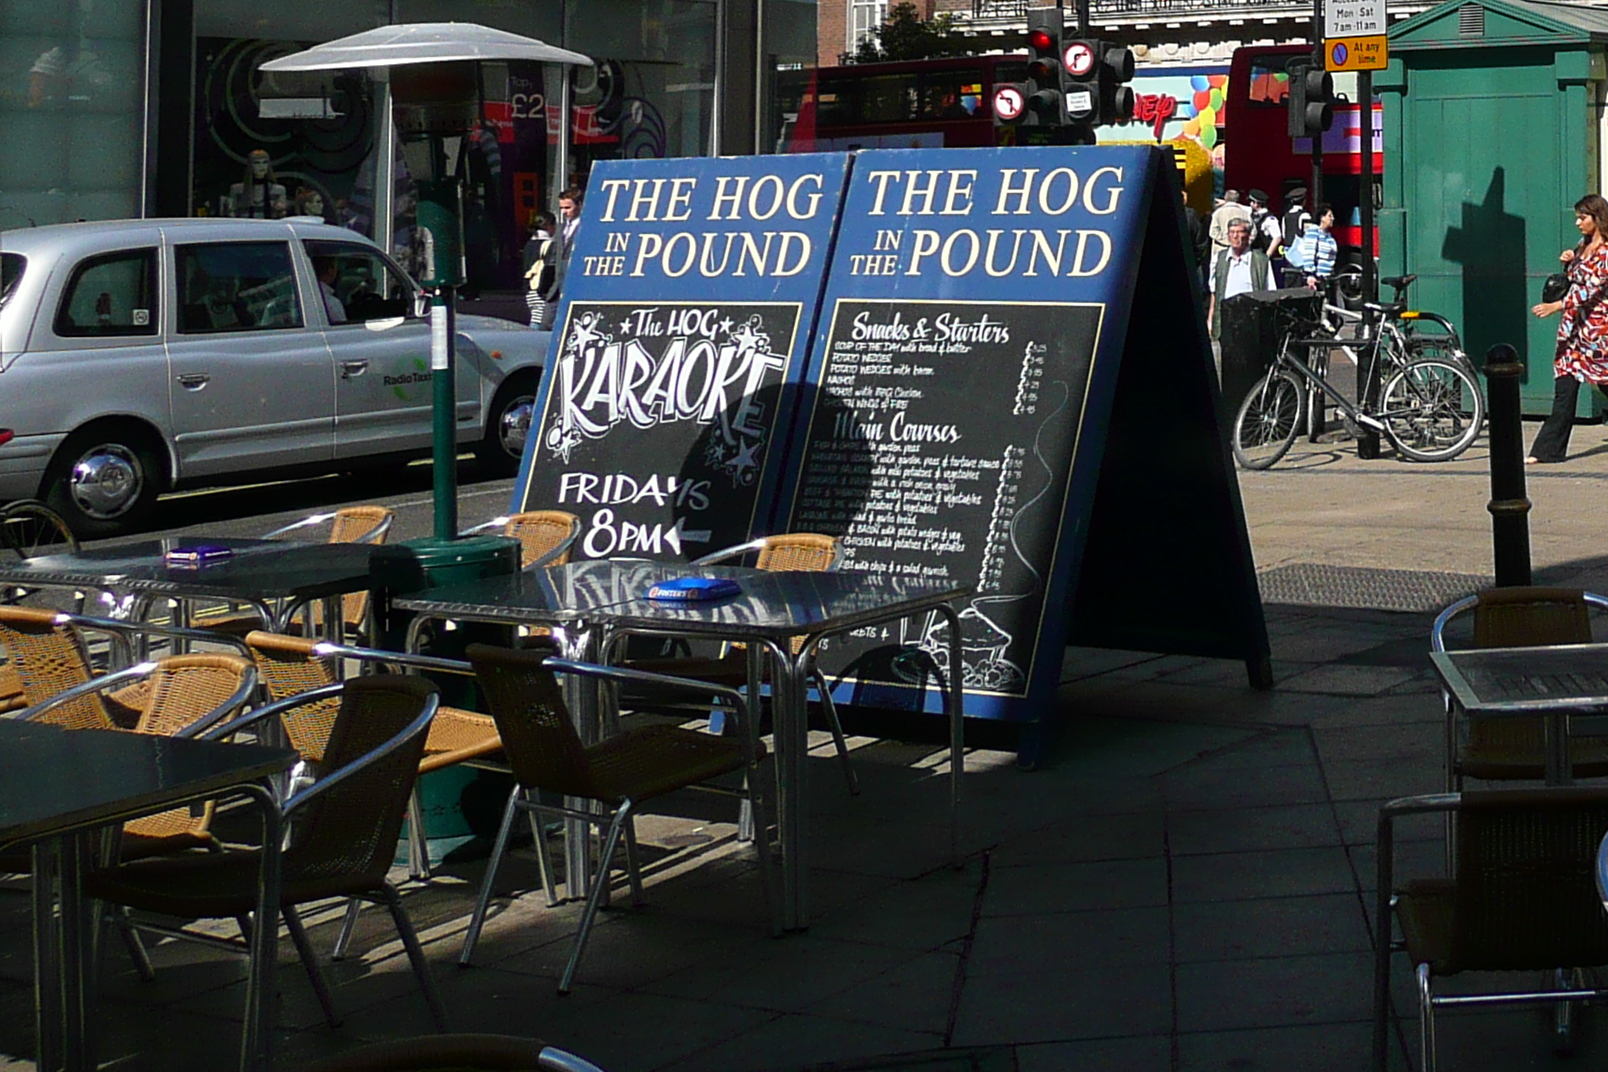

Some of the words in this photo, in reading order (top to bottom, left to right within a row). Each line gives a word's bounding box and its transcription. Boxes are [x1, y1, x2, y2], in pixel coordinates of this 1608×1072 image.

[1359, 7, 1374, 18] Sat
[510, 92, 545, 119] £2
[599, 177, 698, 223] THE
[705, 173, 824, 222] HOG
[867, 169, 978, 216] THE
[990, 165, 1125, 216] HOG
[583, 255, 627, 276] THE
[628, 231, 812, 278] POUND
[604, 232, 631, 253] IN
[849, 254, 899, 276] THE
[903, 228, 1113, 278] POUND
[872, 229, 904, 251] IN
[631, 306, 665, 337] The
[665, 308, 719, 341] HOG
[851, 310, 911, 342] Snacks
[934, 312, 1010, 344] Starters
[560, 336, 788, 448] KARAOKE
[832, 410, 885, 441] Main
[889, 411, 963, 444] Courses
[558, 471, 712, 511] FRIDAYS
[582, 508, 663, 559] 8PM
